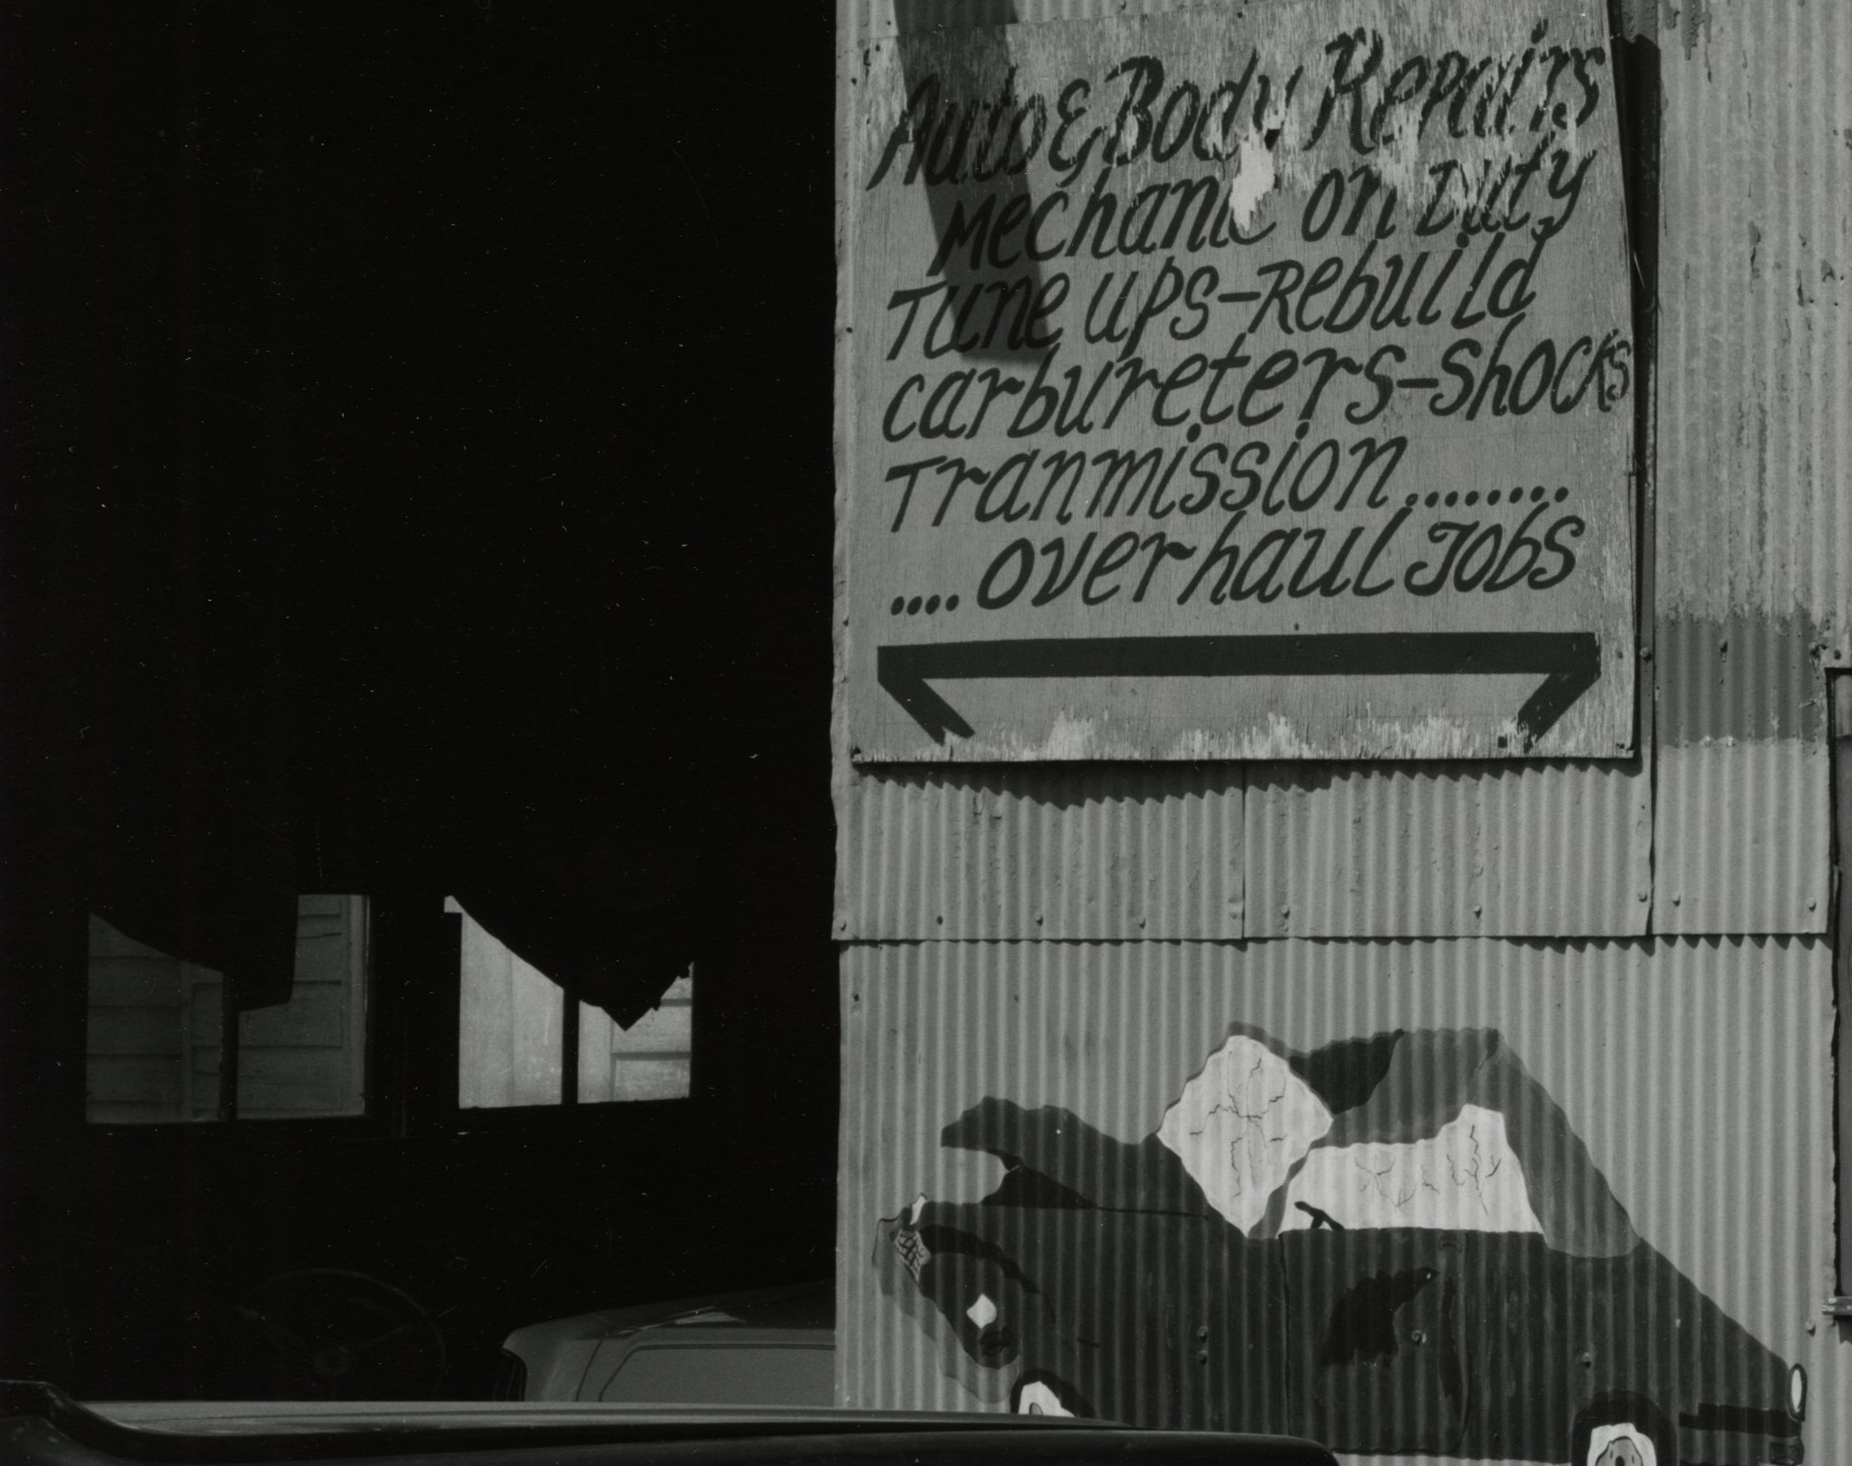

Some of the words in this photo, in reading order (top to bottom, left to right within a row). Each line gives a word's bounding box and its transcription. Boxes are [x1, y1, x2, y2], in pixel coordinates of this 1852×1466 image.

[866, 63, 1048, 192] Auto
[1102, 47, 1304, 169] Body
[1302, 18, 1606, 155] Repairs
[1301, 166, 1397, 242] on
[1414, 131, 1598, 242] Duty
[886, 273, 1071, 362] Tune
